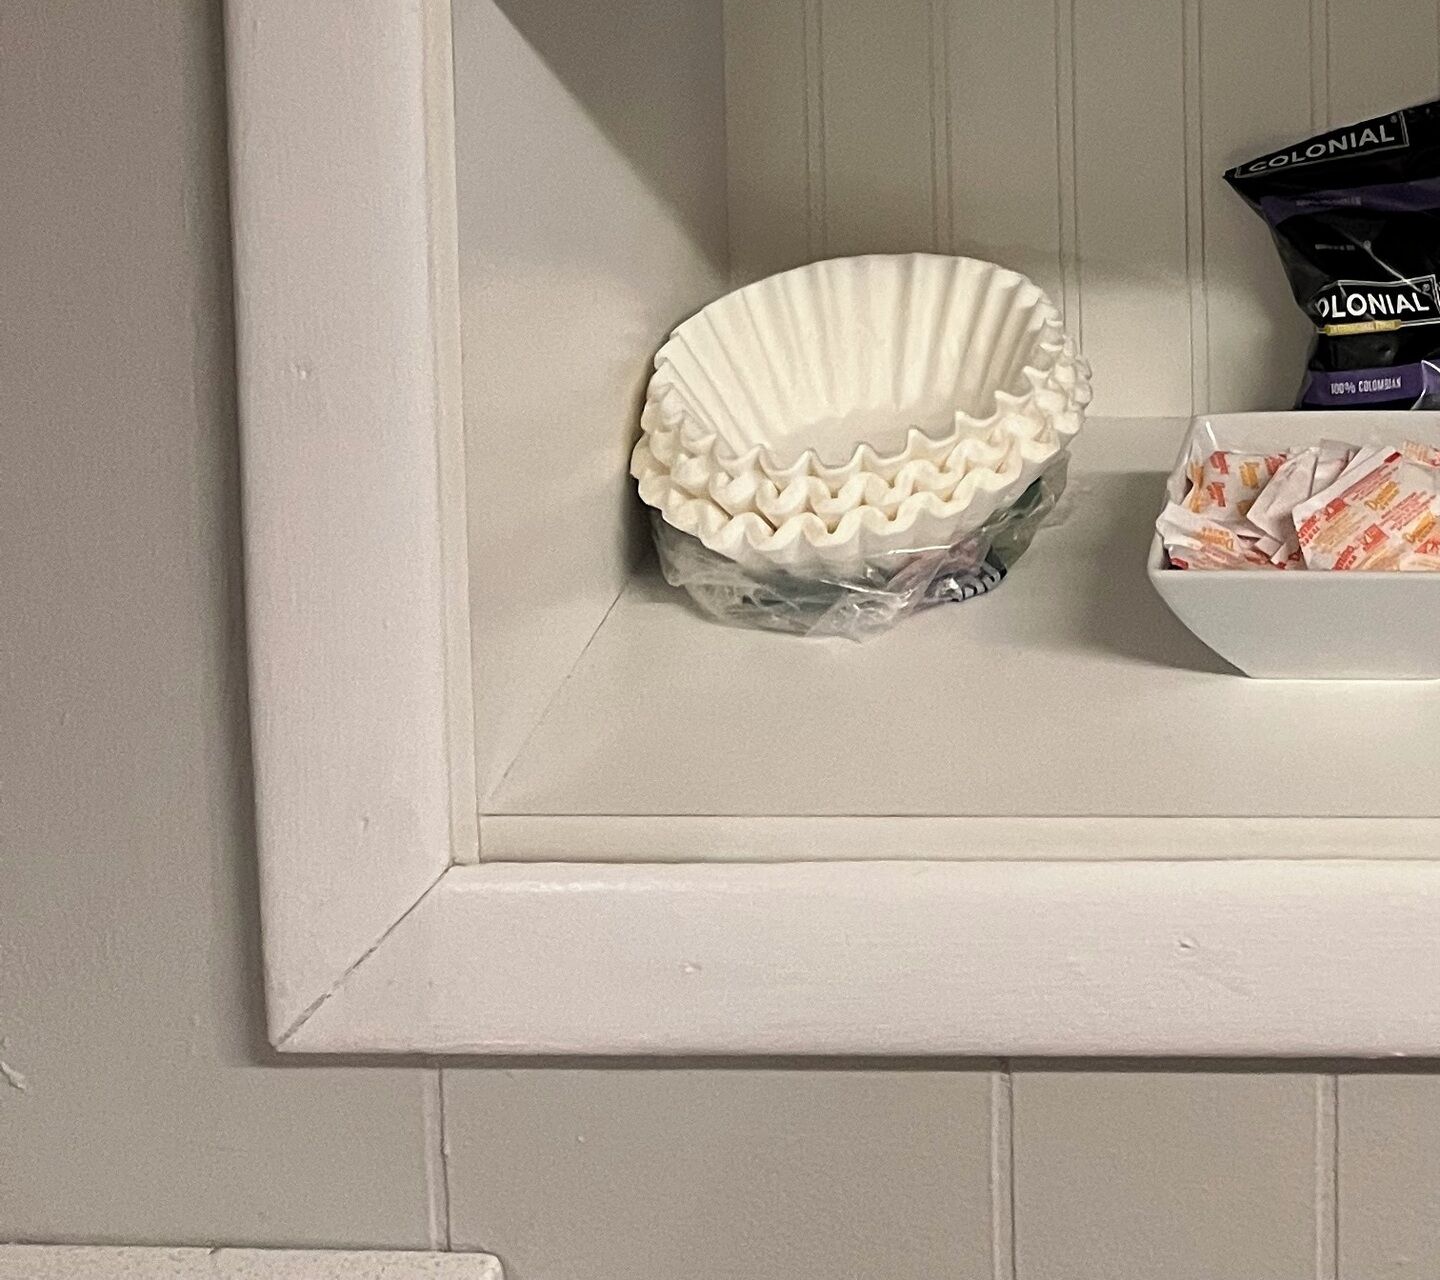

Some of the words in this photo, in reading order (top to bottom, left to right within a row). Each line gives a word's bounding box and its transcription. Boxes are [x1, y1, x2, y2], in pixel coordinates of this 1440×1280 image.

[1249, 124, 1395, 173] COLONIAL
[1315, 292, 1430, 319] OLONIAL
[1330, 381, 1356, 395] 100%
[1358, 375, 1402, 393] COLOMBIAN
